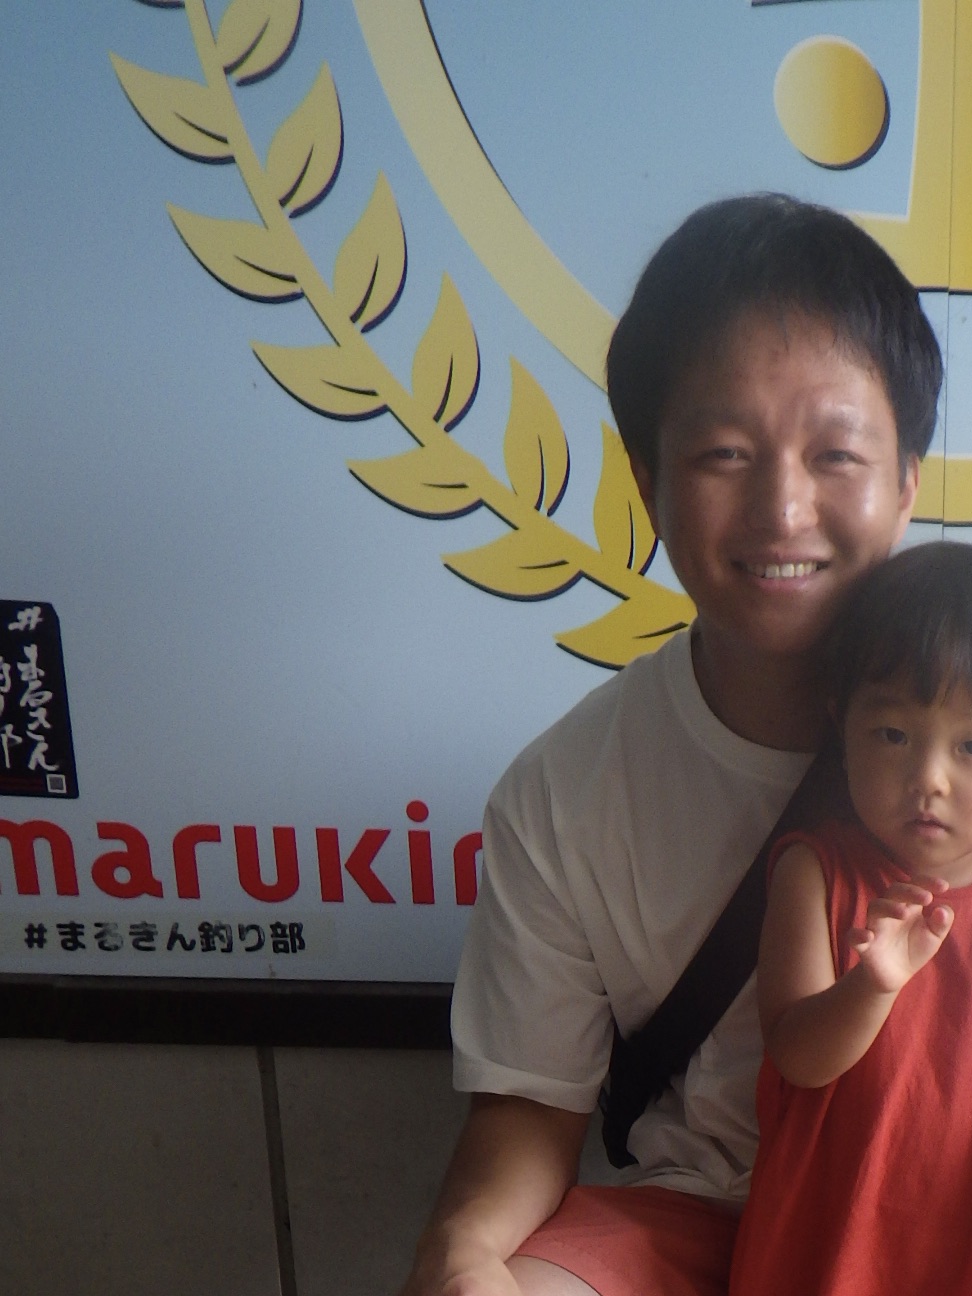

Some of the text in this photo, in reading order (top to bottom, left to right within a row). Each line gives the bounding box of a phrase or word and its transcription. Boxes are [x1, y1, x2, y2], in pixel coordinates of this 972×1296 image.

[23, 919, 307, 954] #まるきん釣り部
